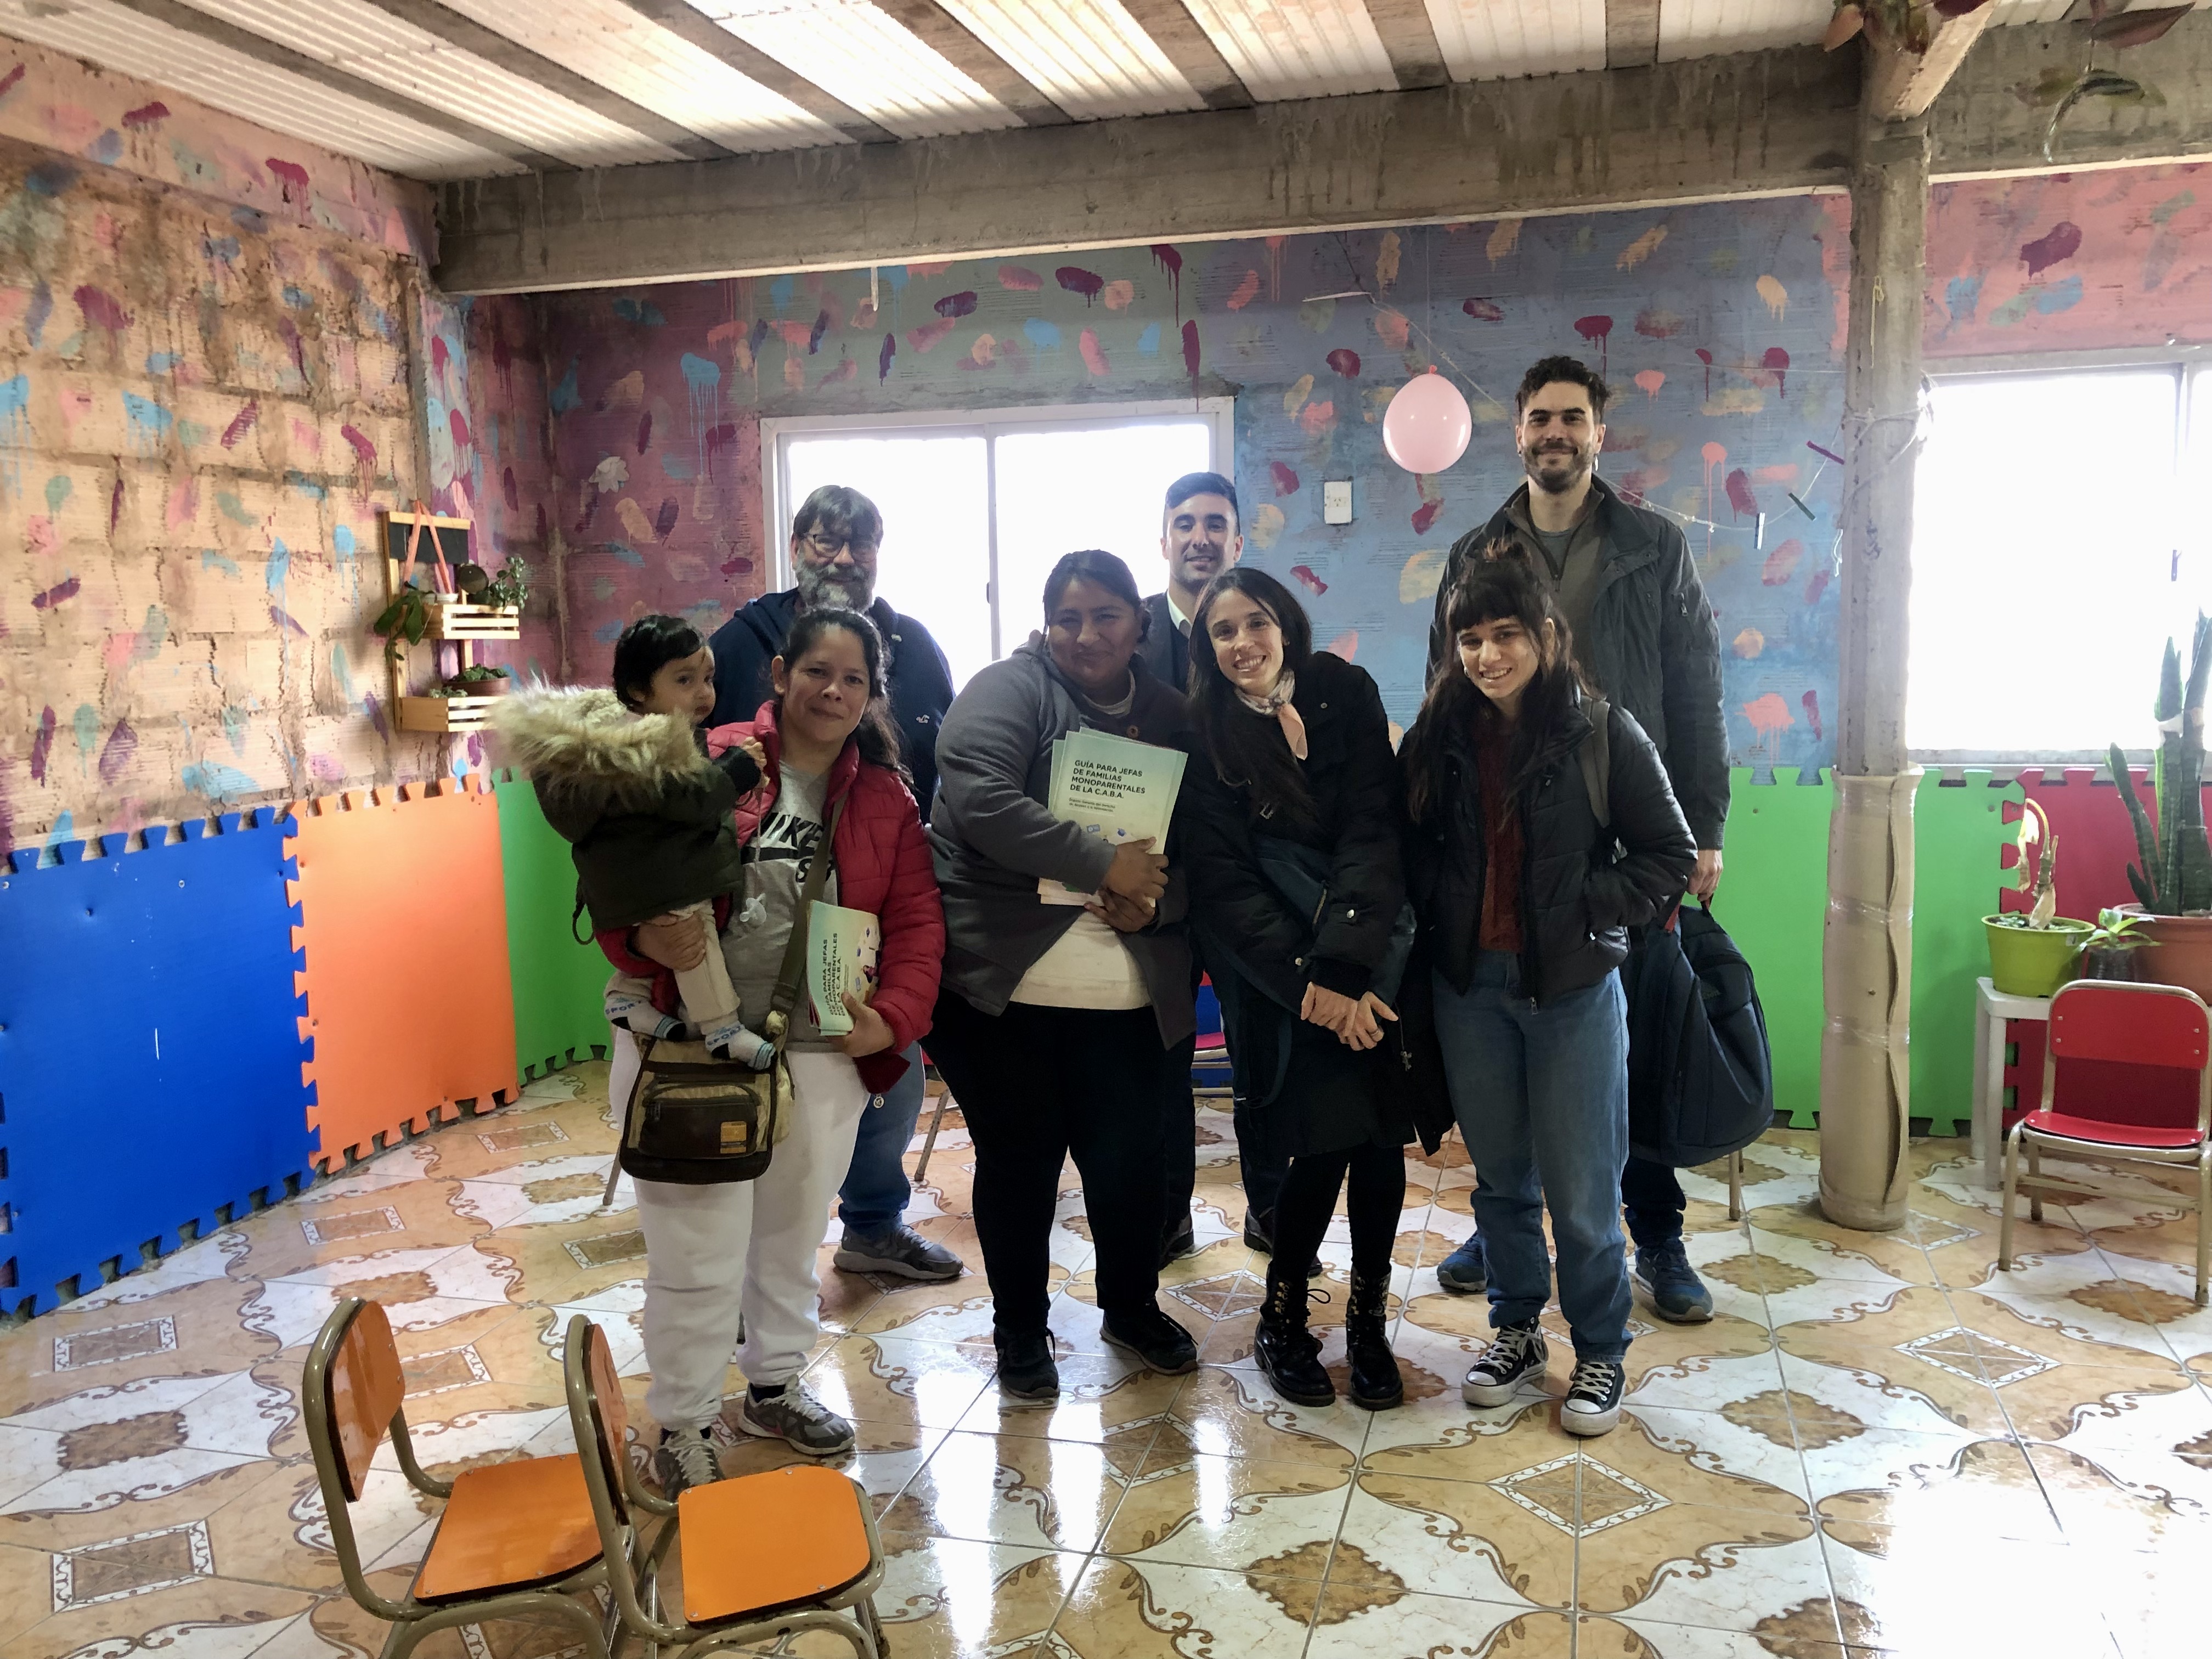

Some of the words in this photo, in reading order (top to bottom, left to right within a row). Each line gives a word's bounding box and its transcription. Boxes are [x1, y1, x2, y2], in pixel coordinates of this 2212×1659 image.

[1075, 760, 1094, 769] GUÍA
[1096, 763, 1117, 773] PARA
[1119, 767, 1143, 777] JEFAS
[1086, 770, 1122, 782] FAMILIAS
[1071, 776, 1146, 794] MONOPARENTALES
[1094, 788, 1124, 799] C.A.B.A.
[832, 933, 842, 1015] MONOPARENTALES
[837, 992, 841, 1003] LA
